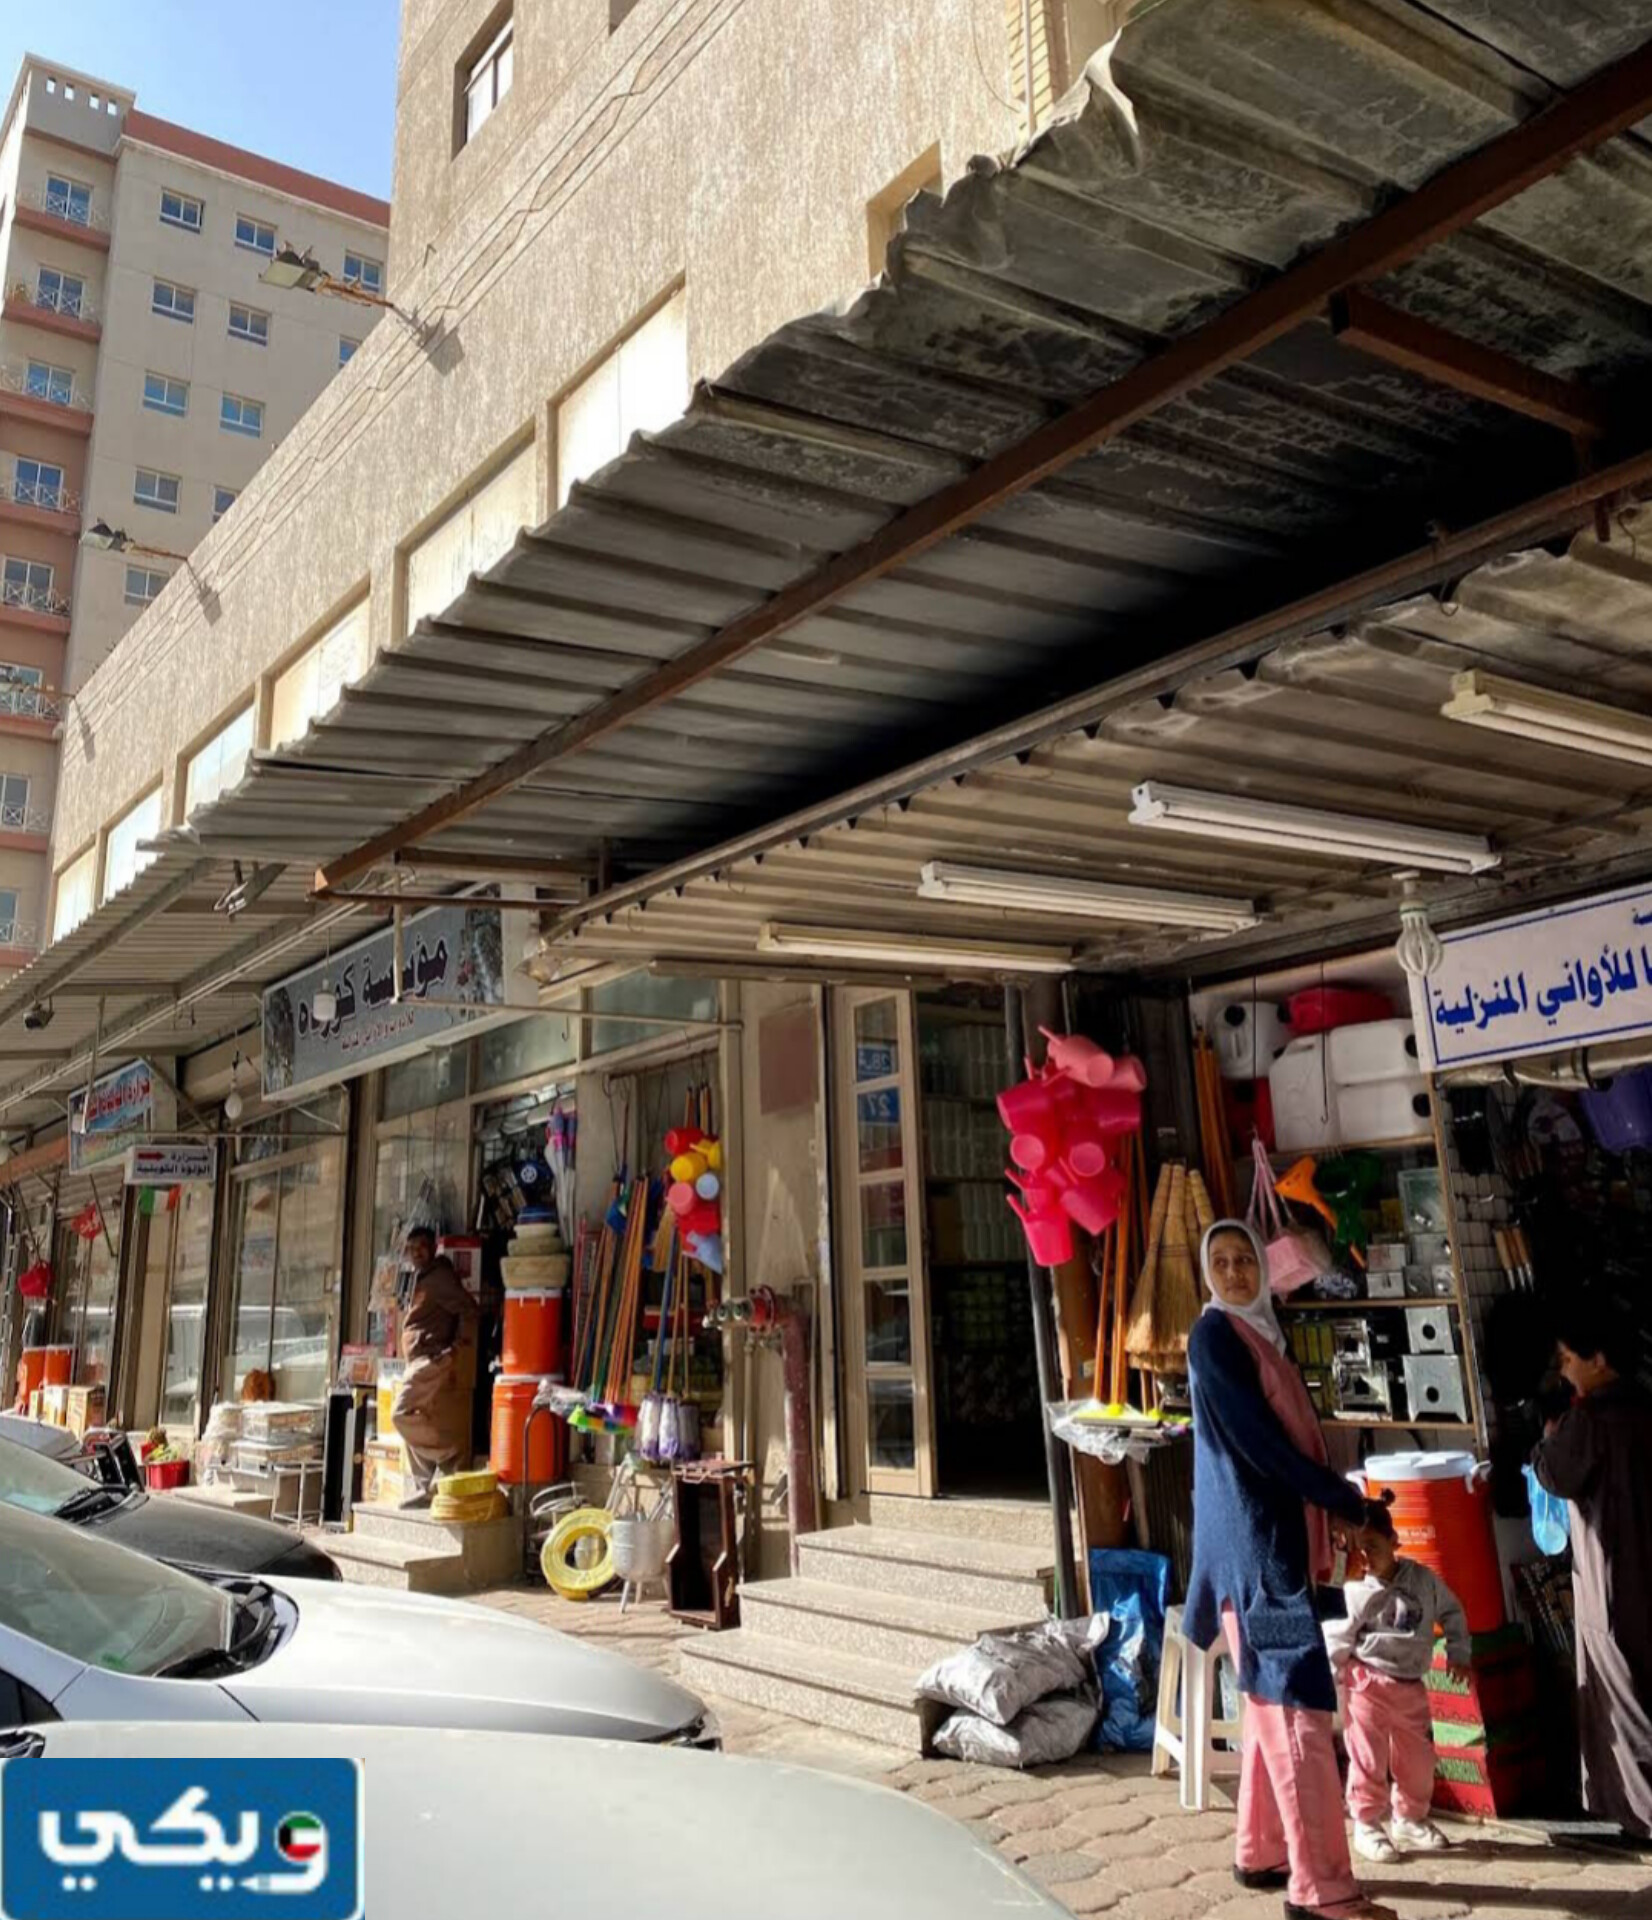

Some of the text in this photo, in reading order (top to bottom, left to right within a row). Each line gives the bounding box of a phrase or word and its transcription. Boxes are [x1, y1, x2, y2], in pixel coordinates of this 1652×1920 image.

[364, 934, 448, 1005] مؤسسة
[1435, 971, 1528, 1034] المنزلية
[1536, 944, 1637, 1026] للأواني
